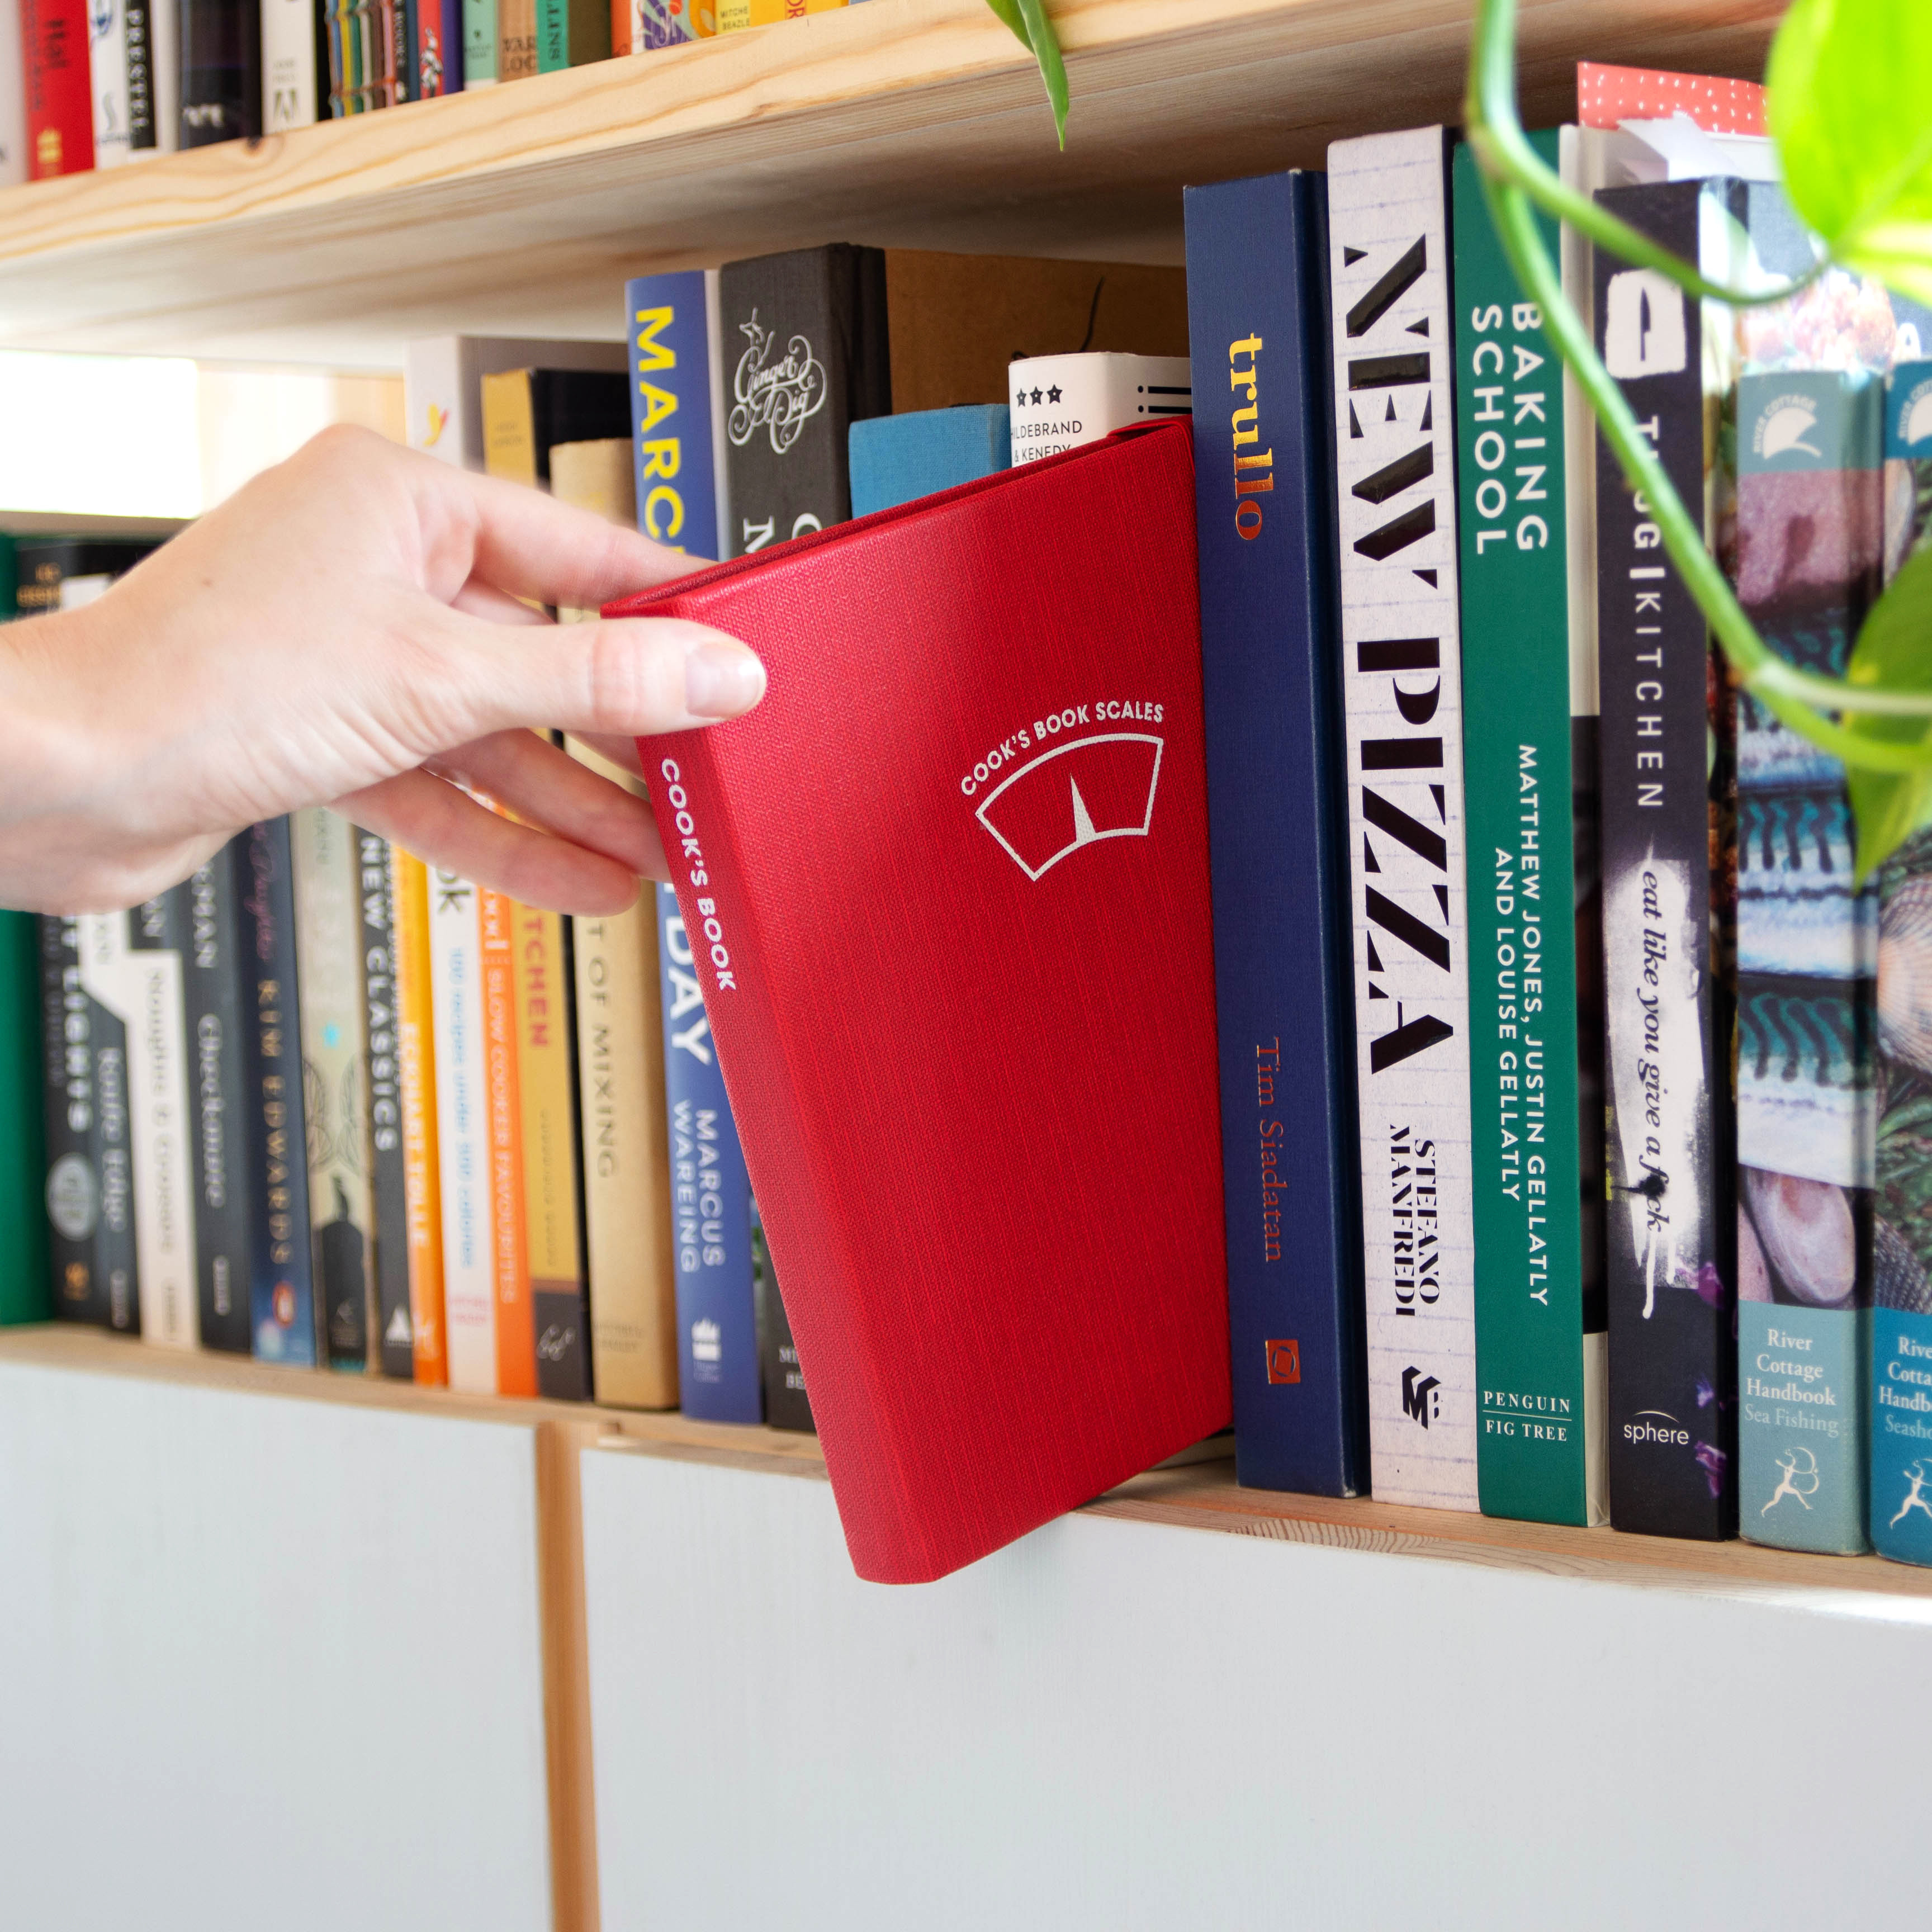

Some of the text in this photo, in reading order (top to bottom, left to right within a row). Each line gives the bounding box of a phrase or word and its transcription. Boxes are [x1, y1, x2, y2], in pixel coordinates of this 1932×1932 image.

[636, 306, 685, 555] MARC
[1014, 449, 1020, 462] &
[1229, 332, 1274, 541] trullo
[1343, 233, 1437, 590] NEW
[1472, 305, 1506, 554] SCHOOL
[1512, 302, 1548, 550] BAKING
[961, 700, 1164, 795] COOK'S BOOK SCALES
[1636, 593, 1663, 806] KITCHEN
[361, 836, 388, 930] NEW
[661, 758, 737, 991] COOK'S BOOK
[1357, 637, 1453, 1074] PIZZA
[366, 945, 398, 1152] CLASSICS
[524, 905, 551, 1048] TCHEN
[1495, 847, 1520, 1201] AND LOUISE GELLATLY
[1519, 745, 1547, 1306] MATTHEW JONES, JUSTIN GELLATLY
[1637, 871, 1670, 1233] eat like you give a fck
[592, 1023, 618, 1177] MIXING
[674, 1098, 700, 1273] WAREING
[695, 1109, 726, 1266] MARCUS
[1257, 1036, 1288, 1262] Tim Siadatan
[1390, 1124, 1415, 1317] MANFREDI
[1415, 1139, 1440, 1305] STEFANO
[1484, 1390, 1570, 1414] PENGUIN
[1744, 1405, 1839, 1438] Sea Fishing
[1747, 1377, 1836, 1406] Handbook
[1756, 1353, 1824, 1383] Cottage
[1767, 1328, 1812, 1351] River
[1485, 1419, 1568, 1442] FIG TREE
[1623, 1423, 1689, 1445] sphere
